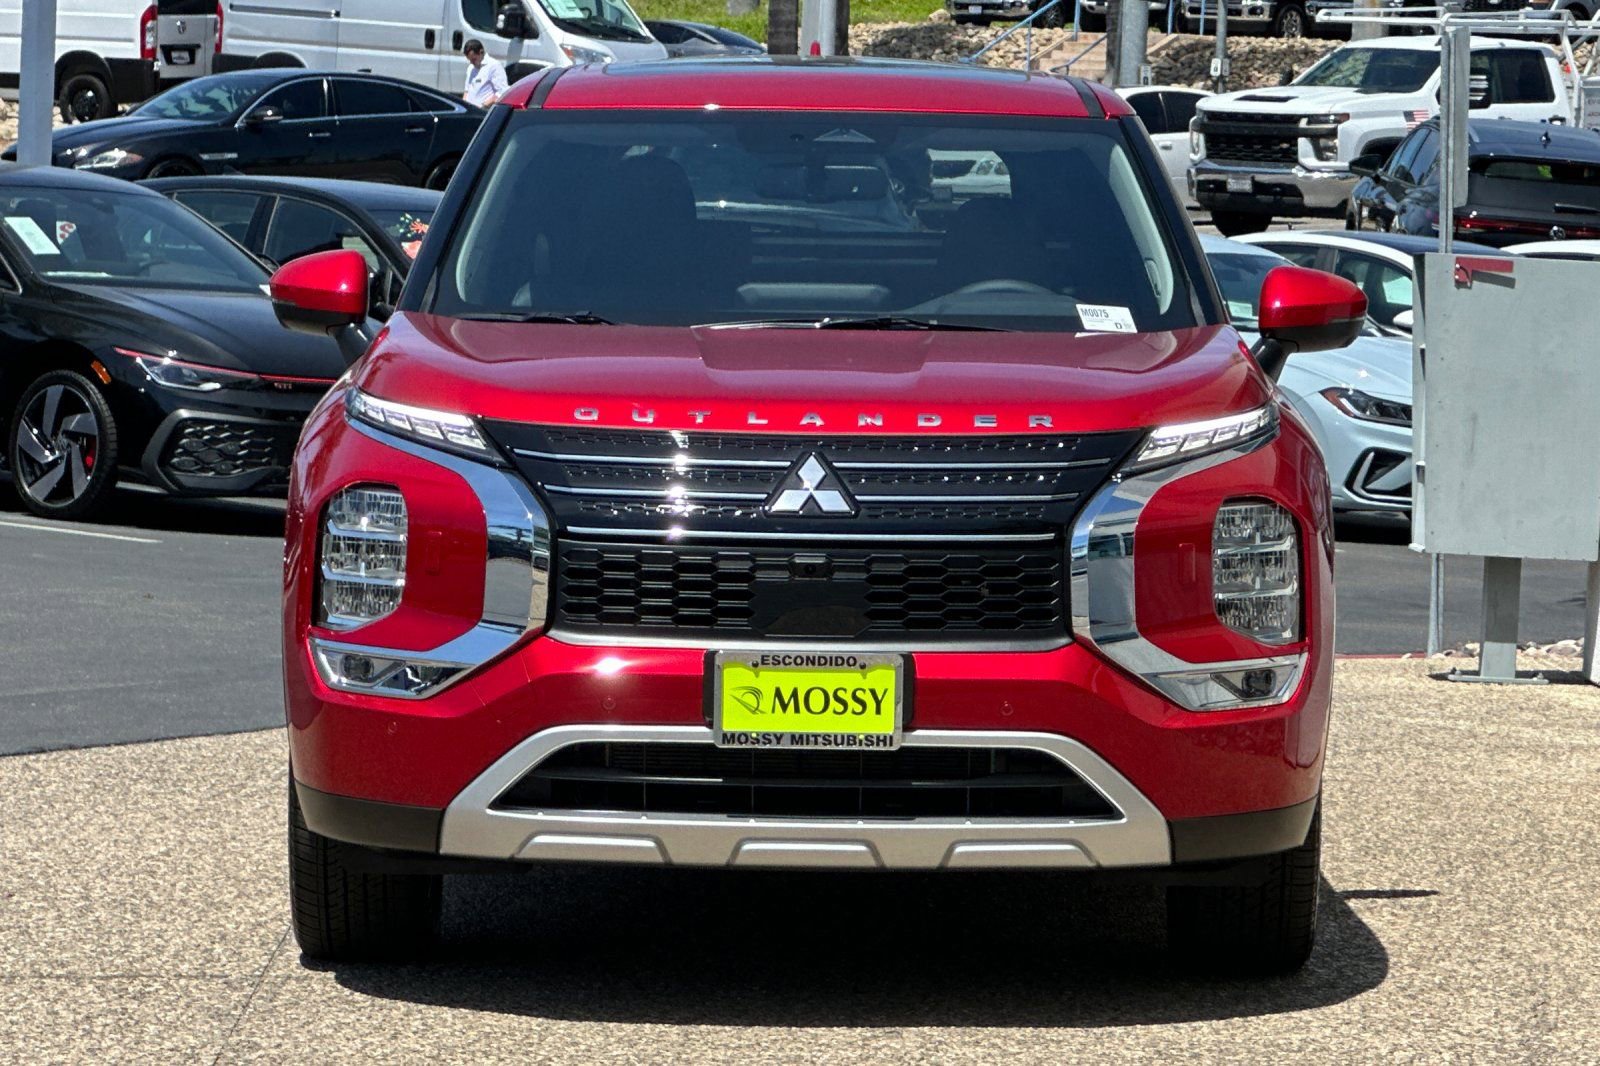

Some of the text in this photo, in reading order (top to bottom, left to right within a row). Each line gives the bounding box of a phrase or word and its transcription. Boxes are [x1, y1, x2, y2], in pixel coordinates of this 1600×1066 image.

[573, 407, 1054, 428] OUTLANDER
[760, 654, 858, 667] ESCONDIDO
[771, 686, 888, 716] MOSSY
[722, 733, 893, 748] MOSSY MITSUBISHI
